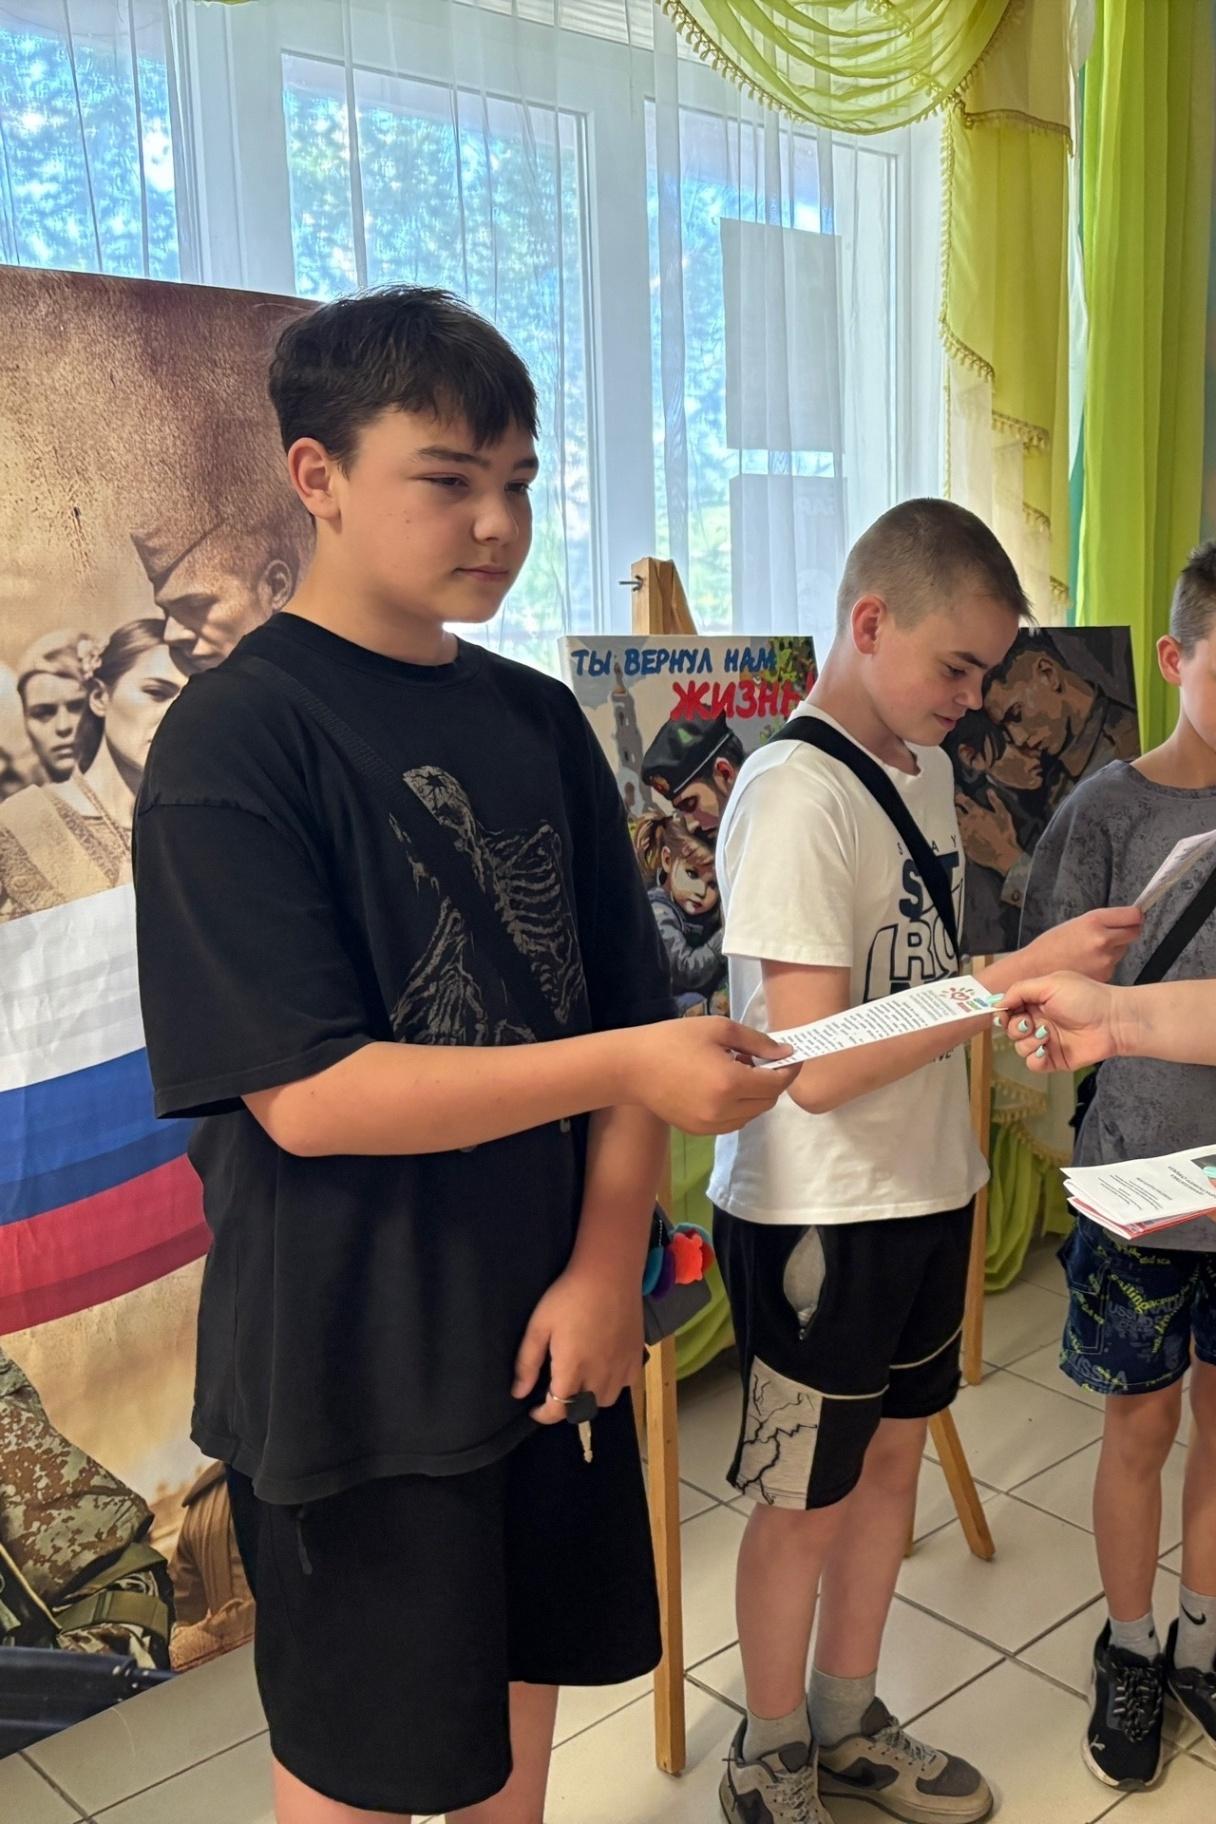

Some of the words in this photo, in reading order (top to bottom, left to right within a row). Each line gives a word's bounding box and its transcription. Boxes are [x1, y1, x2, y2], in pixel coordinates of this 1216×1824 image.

[570, 649, 612, 677] ТЫ
[624, 647, 713, 677] ВЕРНУЛ
[724, 646, 778, 673] НАМ
[896, 834, 958, 855] SAY
